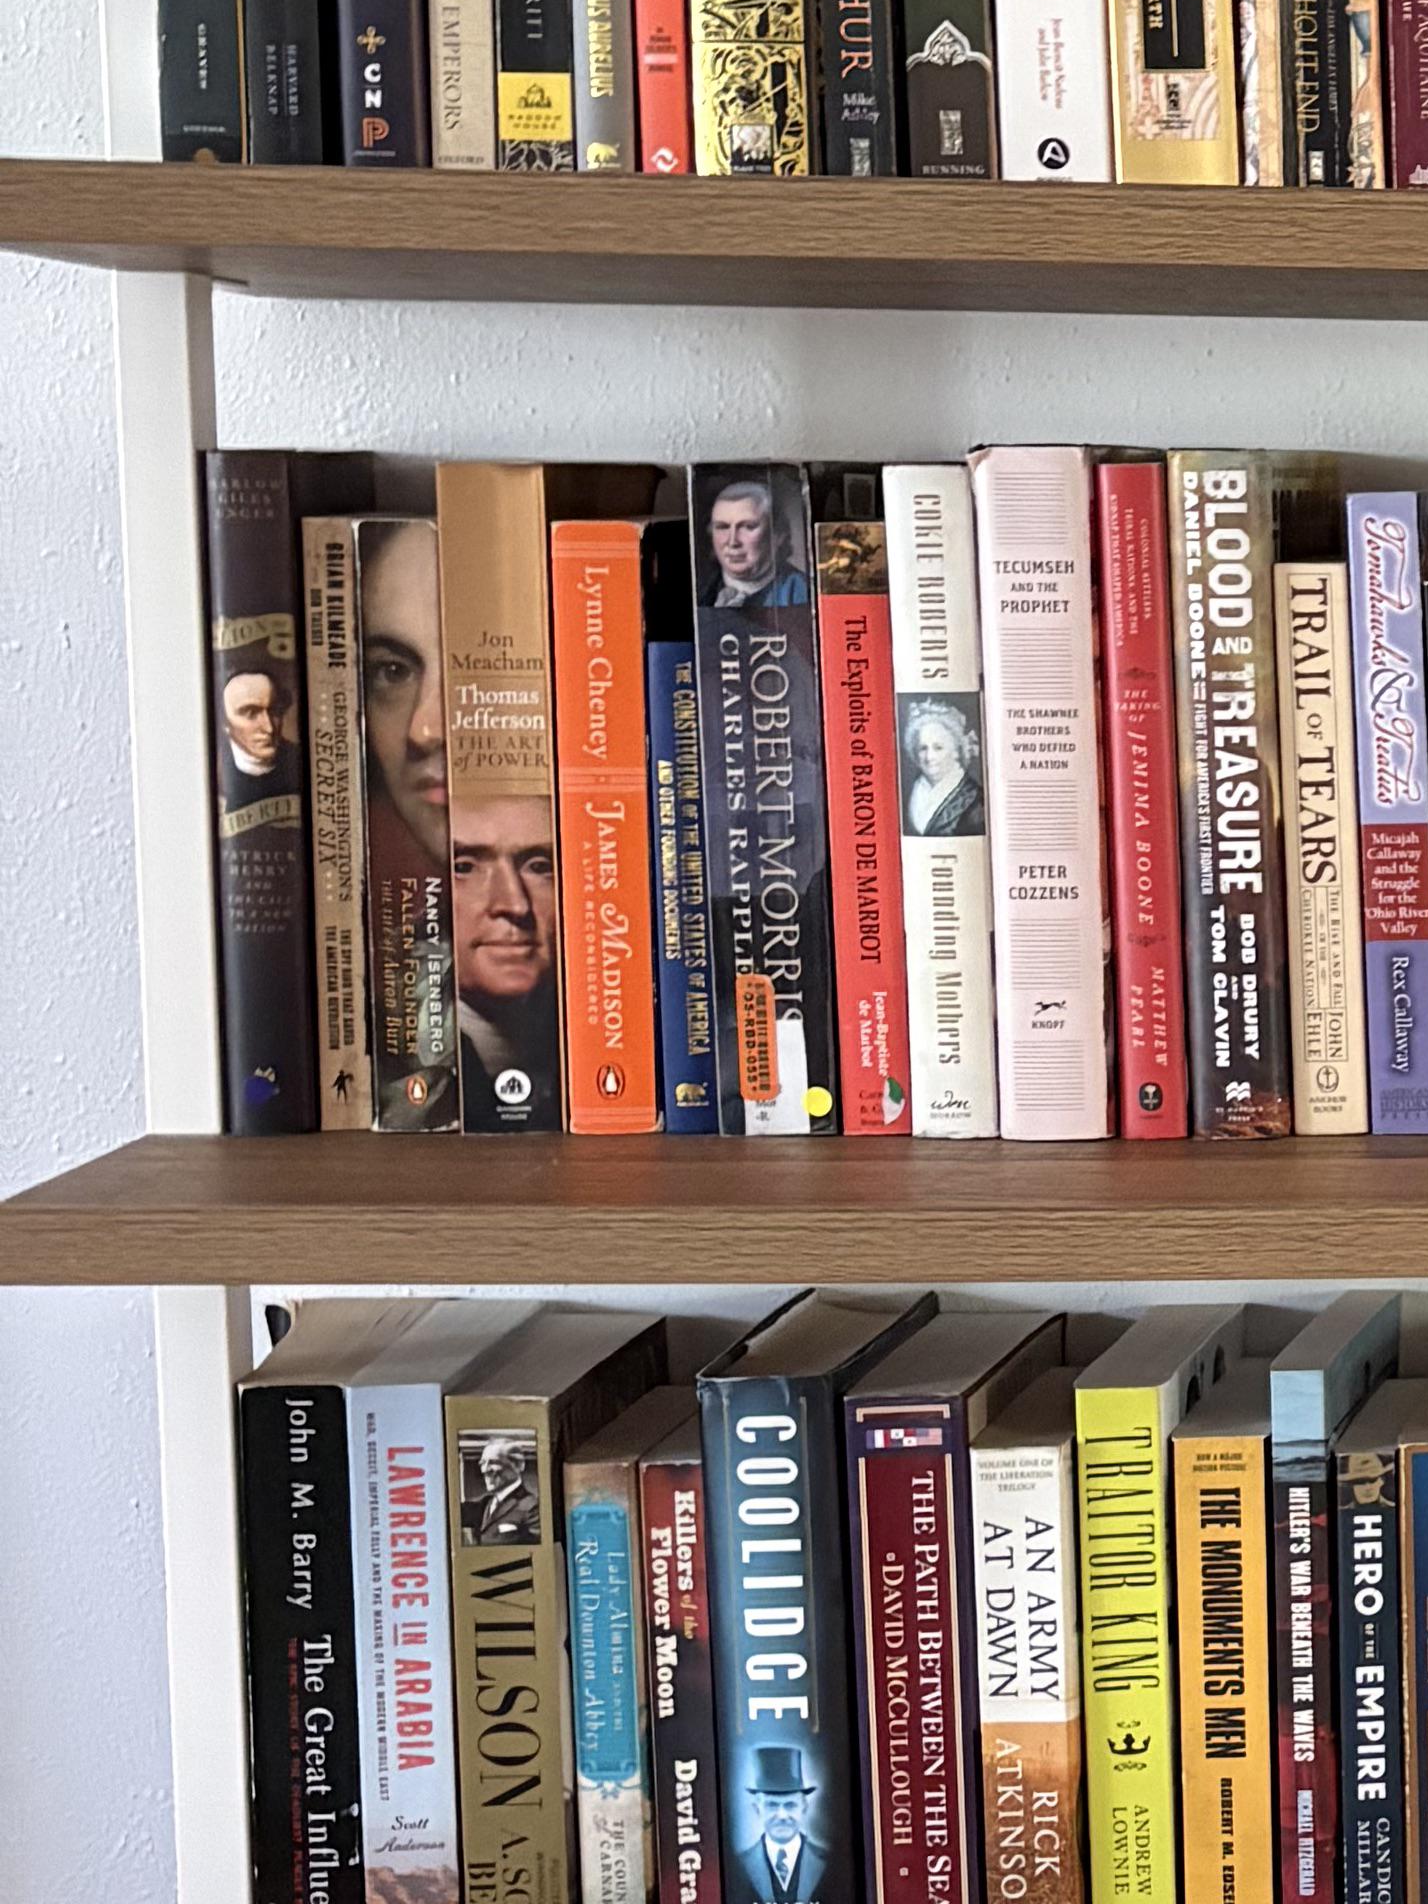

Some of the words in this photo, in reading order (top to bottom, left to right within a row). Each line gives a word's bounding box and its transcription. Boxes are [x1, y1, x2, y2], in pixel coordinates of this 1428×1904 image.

[1202, 471, 1251, 629] BLOOD
[478, 630, 514, 649] Jon
[1213, 637, 1250, 656] AND
[451, 651, 544, 671] Meacham
[455, 685, 539, 706] Thomas
[451, 708, 546, 732] Jefferson
[1213, 663, 1262, 895] TREASURE
[1009, 886, 1080, 900] COZZENS
[1019, 865, 1067, 880] PETER
[1031, 1020, 1065, 1029] KNOPF
[1084, 1428, 1159, 1588] TRAITOR
[1199, 1488, 1242, 1530] THE
[736, 1414, 808, 1721] COOLIDGE
[1200, 1540, 1245, 1696] MONUMENTS
[1091, 1600, 1160, 1692] KING
[470, 1554, 543, 1811] WILSON
[1204, 1708, 1247, 1759] MEN
